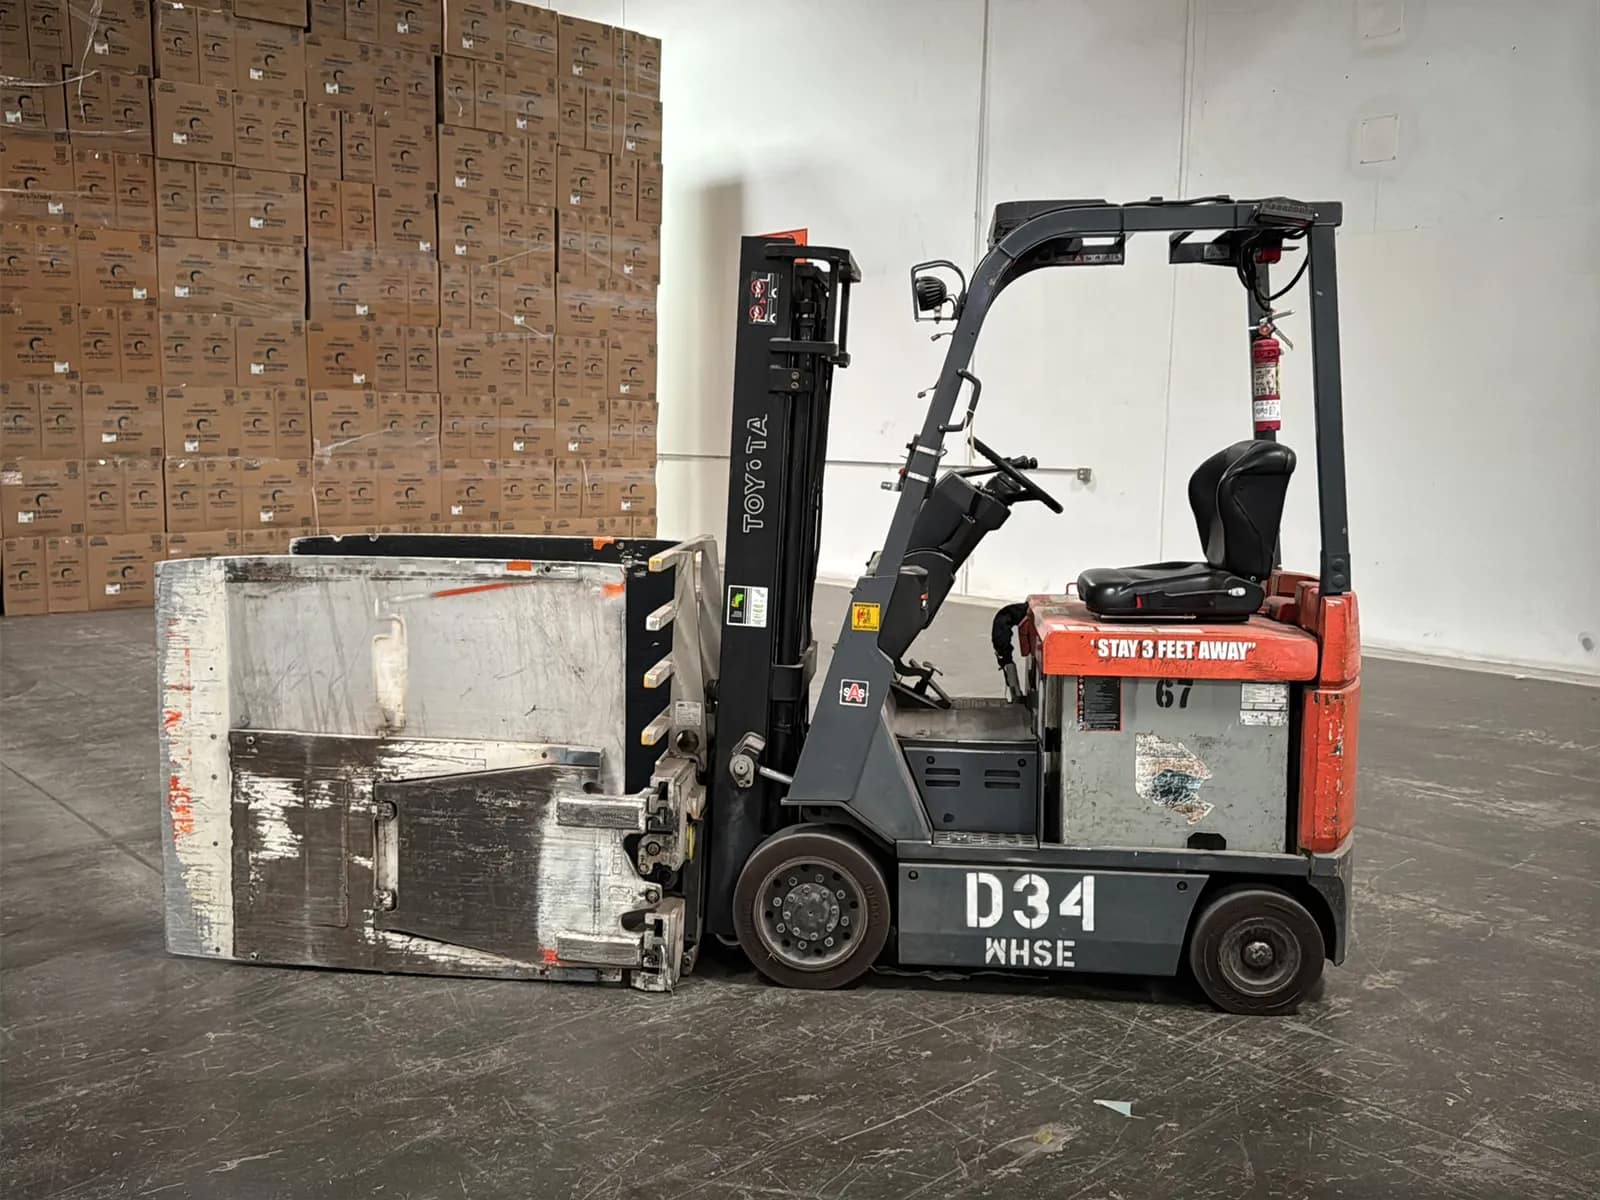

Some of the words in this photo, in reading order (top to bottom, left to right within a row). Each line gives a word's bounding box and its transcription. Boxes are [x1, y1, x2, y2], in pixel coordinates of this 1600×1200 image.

[742, 412, 769, 534] TOYOTA
[1141, 639, 1154, 660] 3
[1157, 640, 1195, 660] FEET
[1155, 678, 1194, 709] 67
[965, 871, 1095, 932] D34
[985, 936, 1076, 967] WHSE
